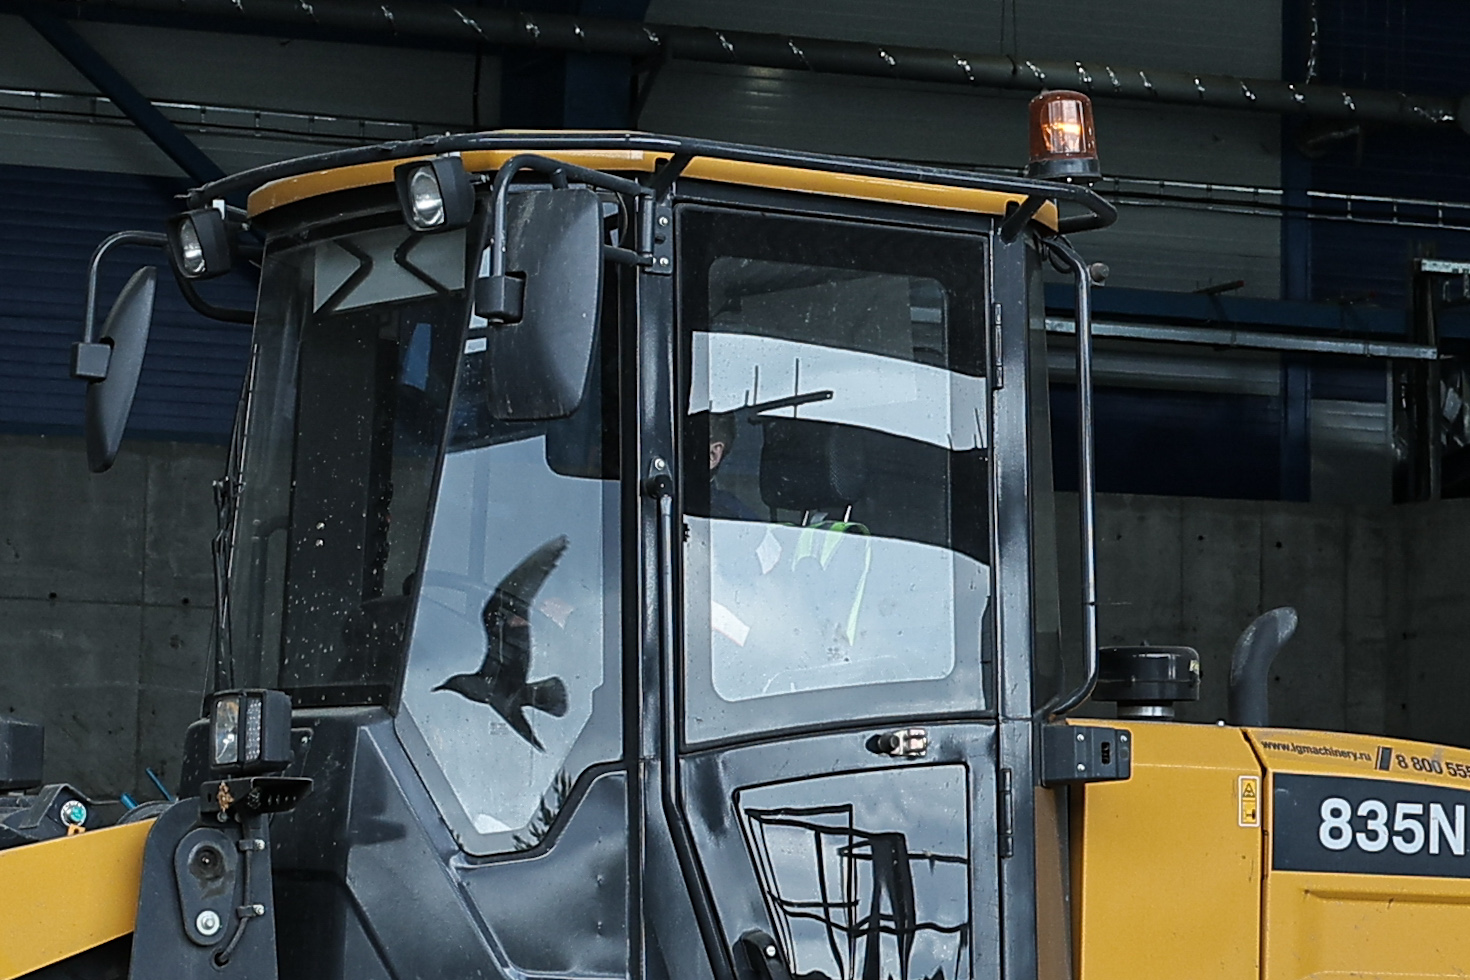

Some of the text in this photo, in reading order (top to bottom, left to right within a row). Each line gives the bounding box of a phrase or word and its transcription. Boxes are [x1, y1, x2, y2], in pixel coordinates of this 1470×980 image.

[1396, 754, 1409, 769] 8
[1410, 756, 1443, 774] 800
[1318, 797, 1466, 856] 835N
